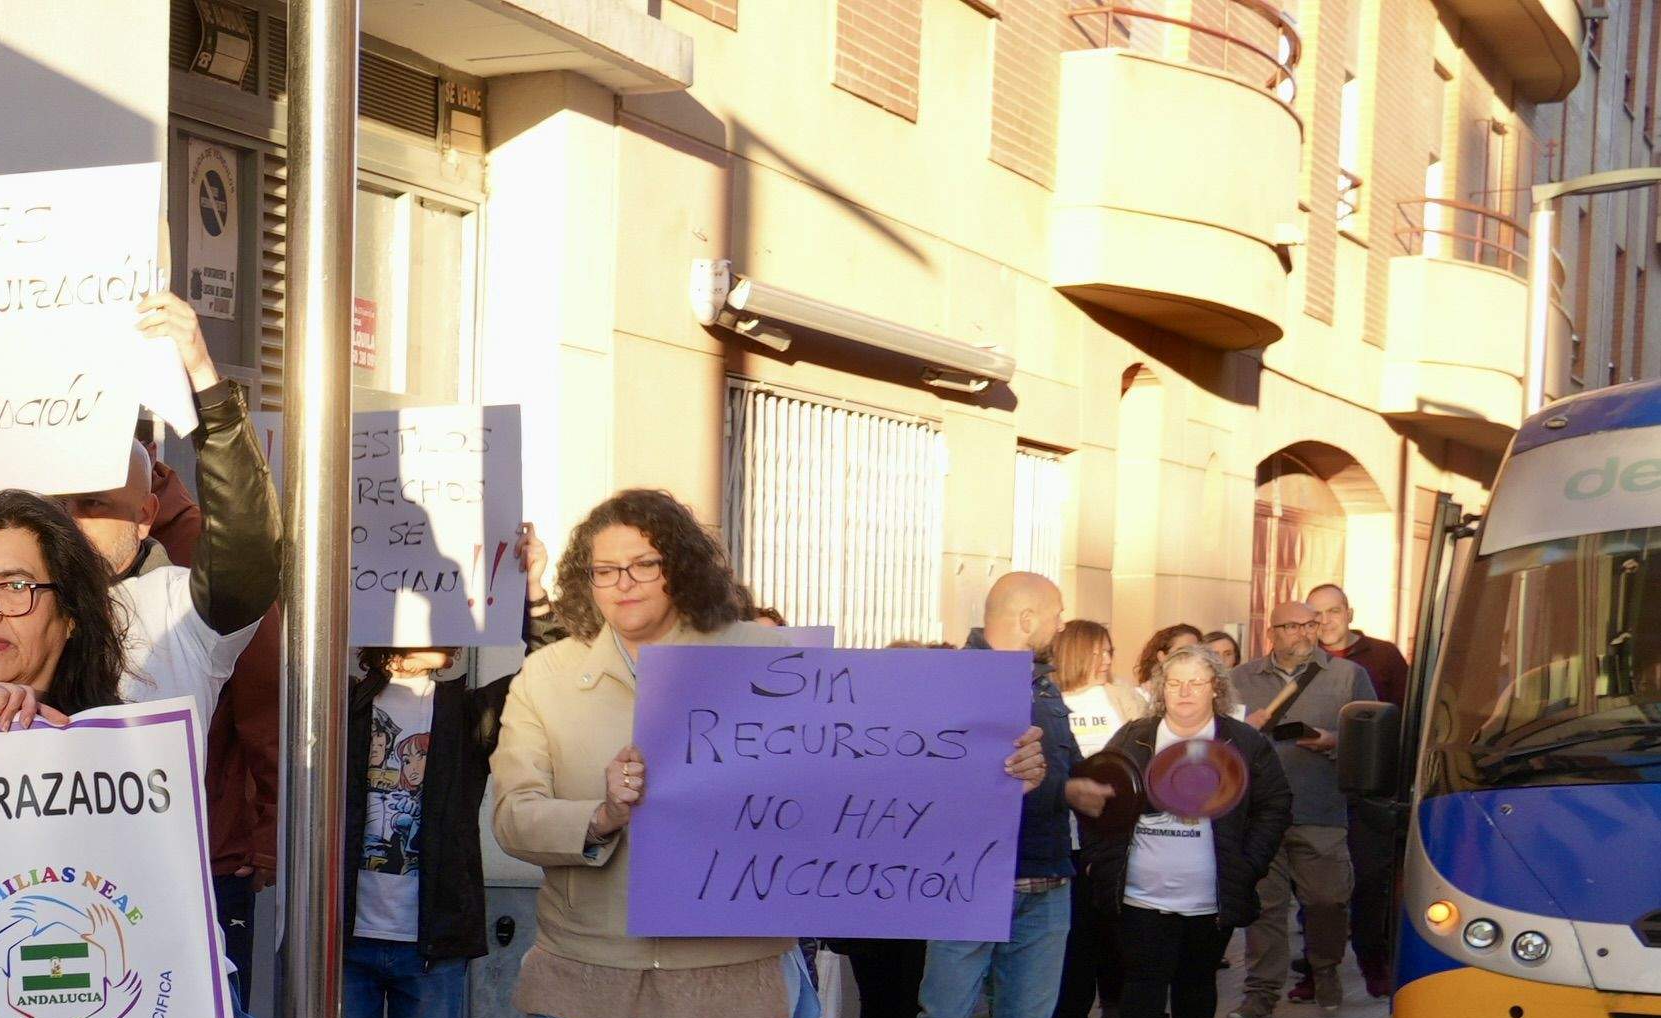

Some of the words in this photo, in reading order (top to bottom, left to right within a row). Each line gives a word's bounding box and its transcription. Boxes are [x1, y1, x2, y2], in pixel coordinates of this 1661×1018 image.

[357, 477, 485, 505] RECHOS
[1564, 456, 1661, 501] de
[389, 521, 426, 546] SE
[350, 570, 459, 593] OCIAN
[686, 708, 969, 764] RECURSOS
[1092, 716, 1108, 726] DE
[734, 794, 804, 831] NO
[832, 794, 934, 839] HAY
[698, 840, 999, 902] INCLUSIÓN
[82, 870, 144, 926] NEAE
[17, 993, 103, 1007] ANDALUCIA
